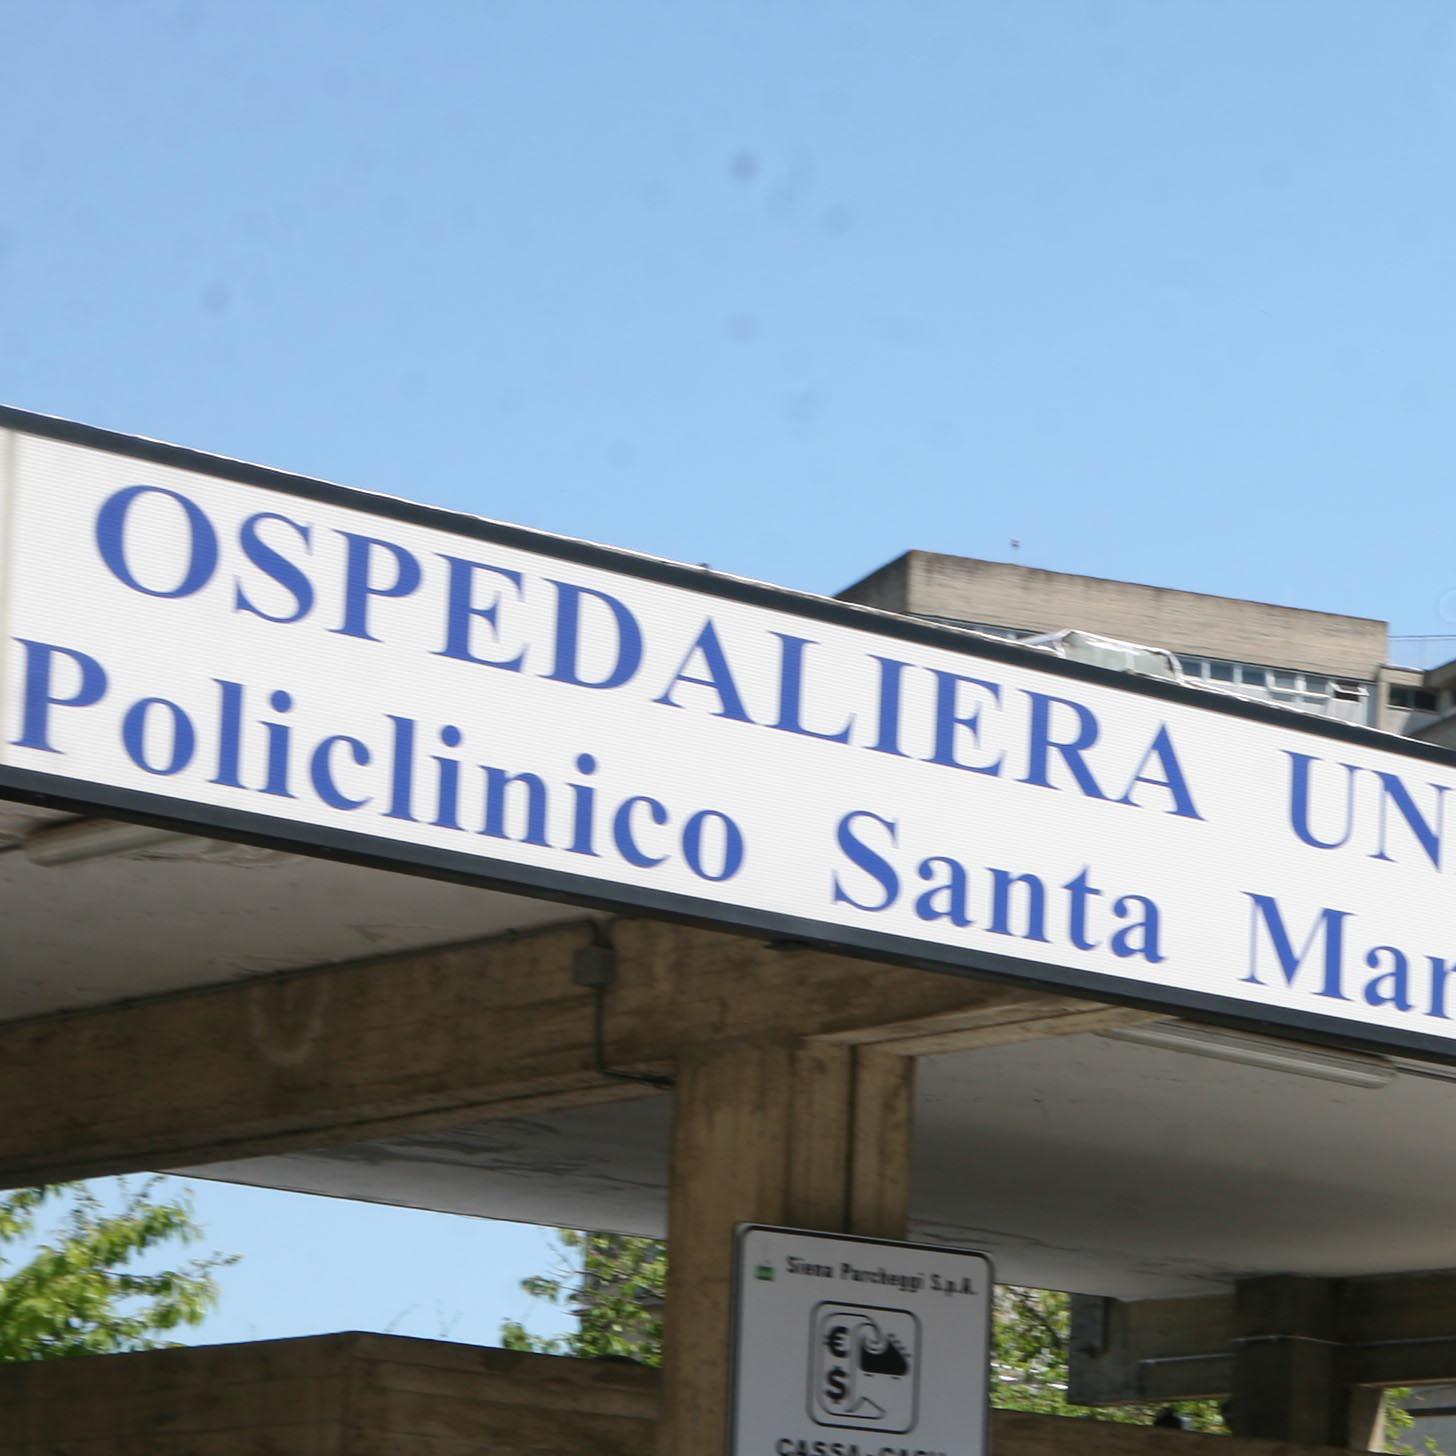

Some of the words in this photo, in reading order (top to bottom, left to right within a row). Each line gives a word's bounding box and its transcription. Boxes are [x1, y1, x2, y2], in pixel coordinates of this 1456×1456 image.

[8, 637, 746, 882] Policlinico
[832, 810, 1165, 963] Santa
[94, 484, 1206, 821] OSPEDALIERA
[786, 1255, 834, 1278] Siena
[840, 1262, 925, 1292] Parcheggi
[930, 1273, 979, 1295] S.p.A.
